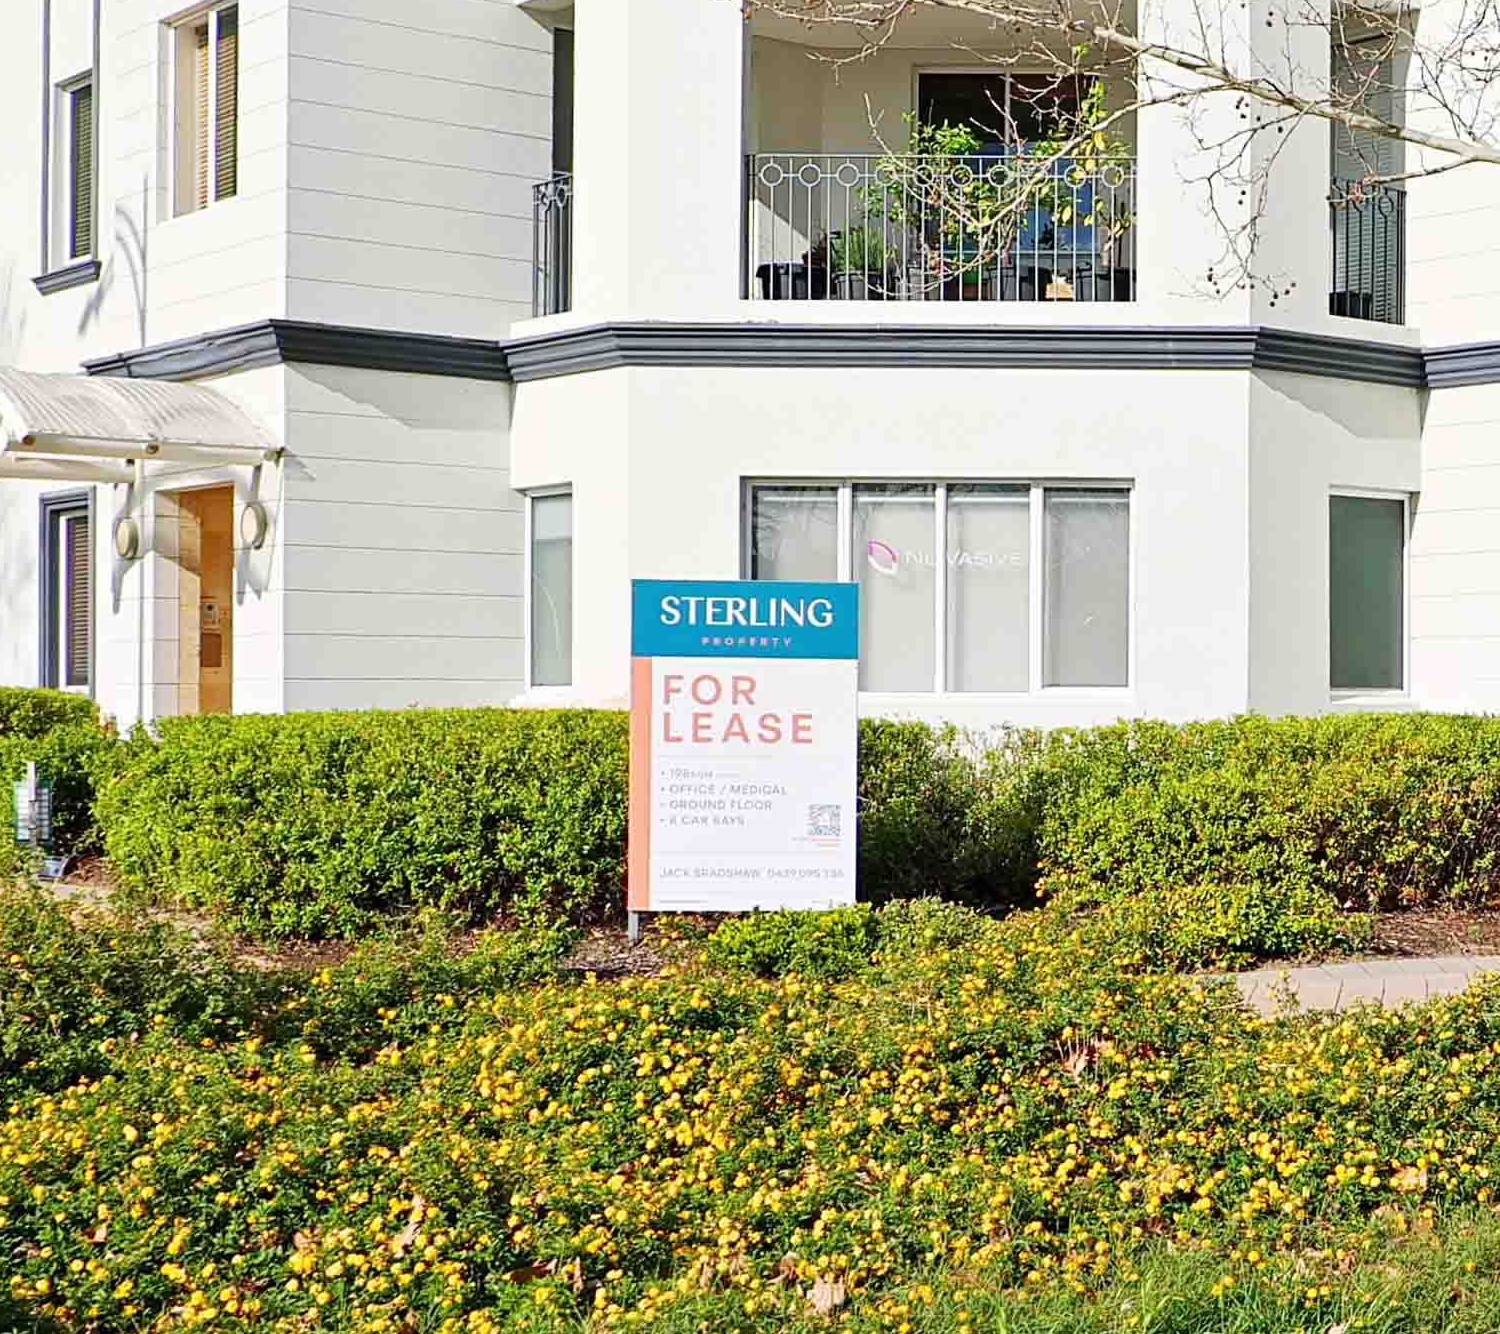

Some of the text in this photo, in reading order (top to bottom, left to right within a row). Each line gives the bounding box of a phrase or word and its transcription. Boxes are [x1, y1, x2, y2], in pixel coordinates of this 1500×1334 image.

[659, 595, 834, 628] STERLING
[701, 636, 792, 647] PROPERTY
[662, 674, 757, 706] FOR
[662, 712, 813, 744] LEASE
[668, 784, 716, 795] OFFICE
[729, 785, 788, 796] MEDICAL
[668, 799, 773, 811] GROUND FLOOR
